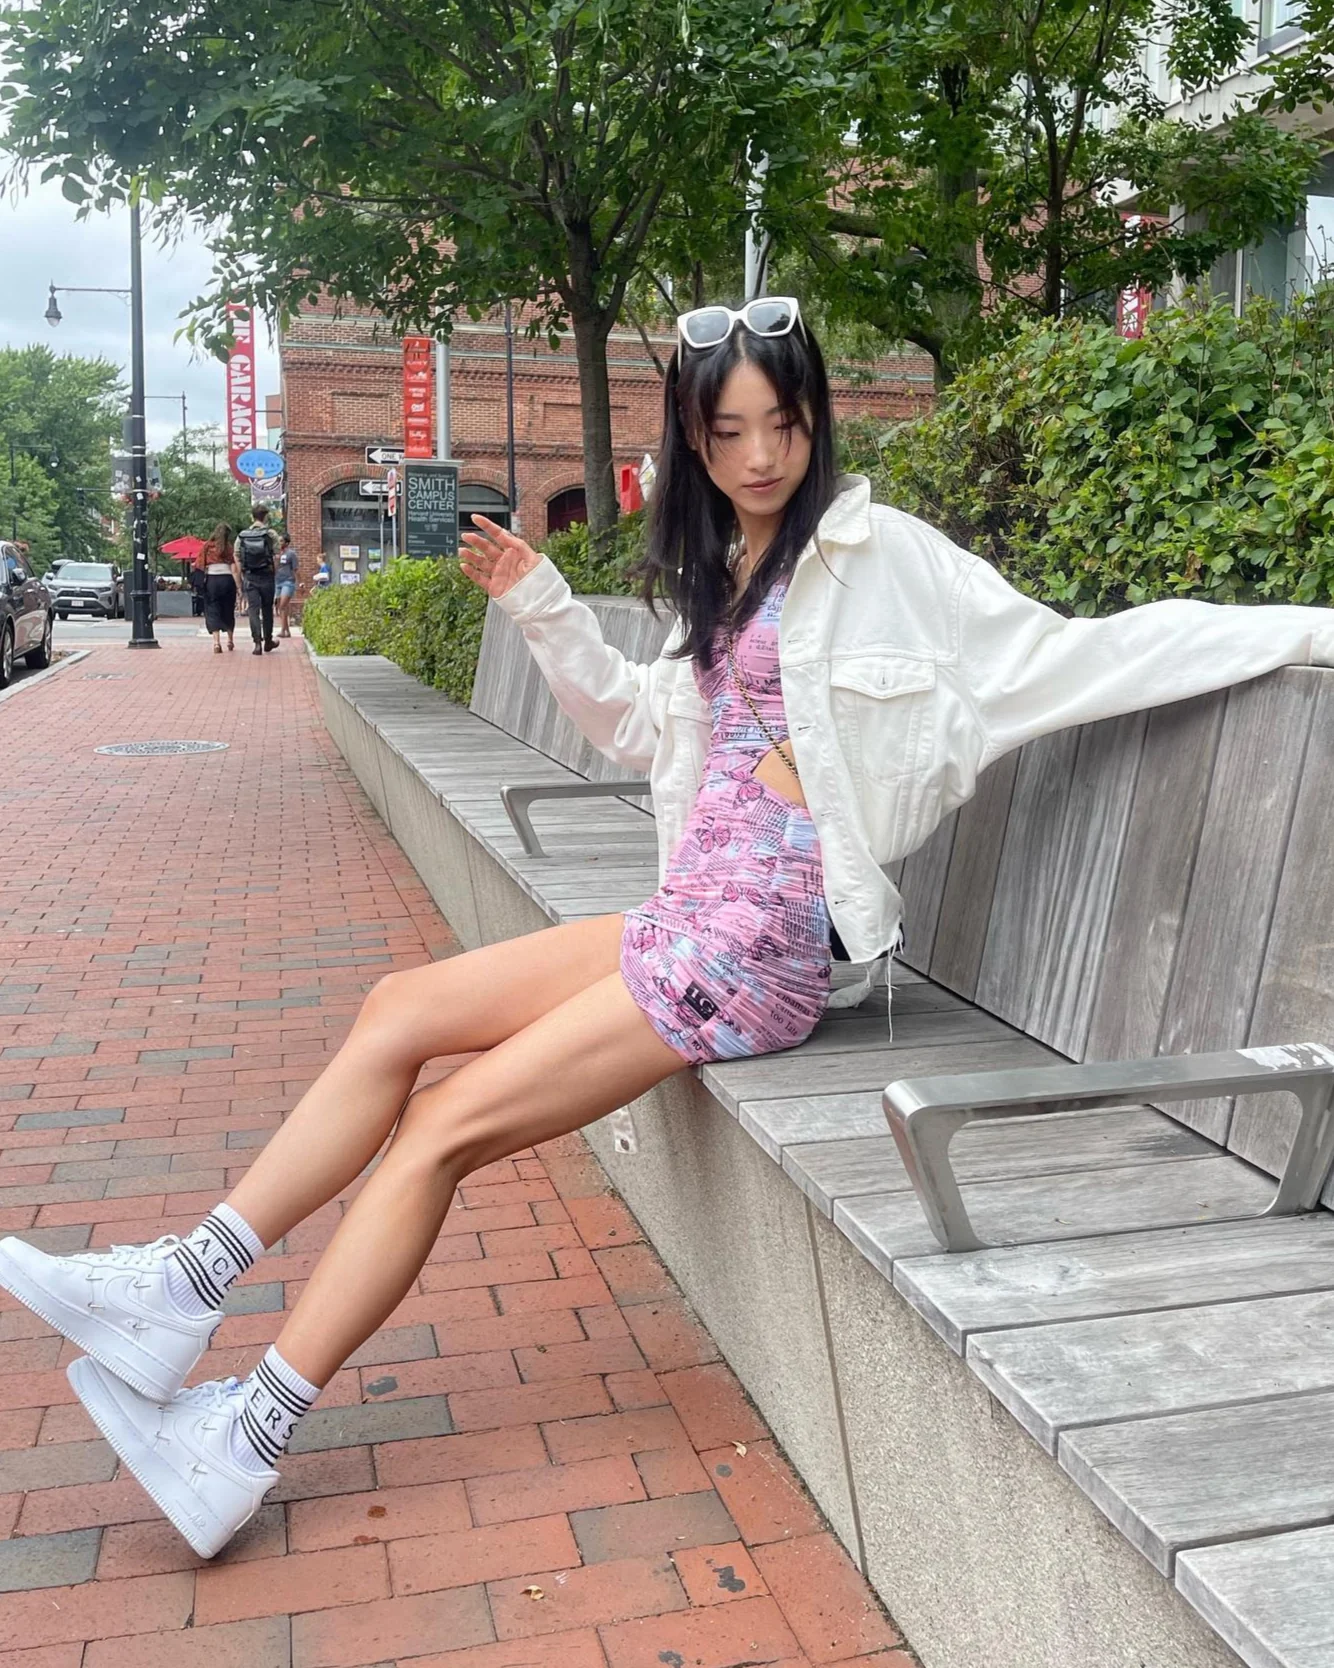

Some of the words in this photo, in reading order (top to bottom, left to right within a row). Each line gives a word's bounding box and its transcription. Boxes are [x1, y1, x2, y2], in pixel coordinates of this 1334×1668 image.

[230, 354, 252, 450] GARAGE
[381, 452, 396, 460] ONE
[408, 477, 455, 491] SMITH
[408, 490, 455, 500] CAMPUS
[408, 500, 455, 511] CENTER
[770, 1010, 784, 1024] too
[784, 1021, 798, 1037] late
